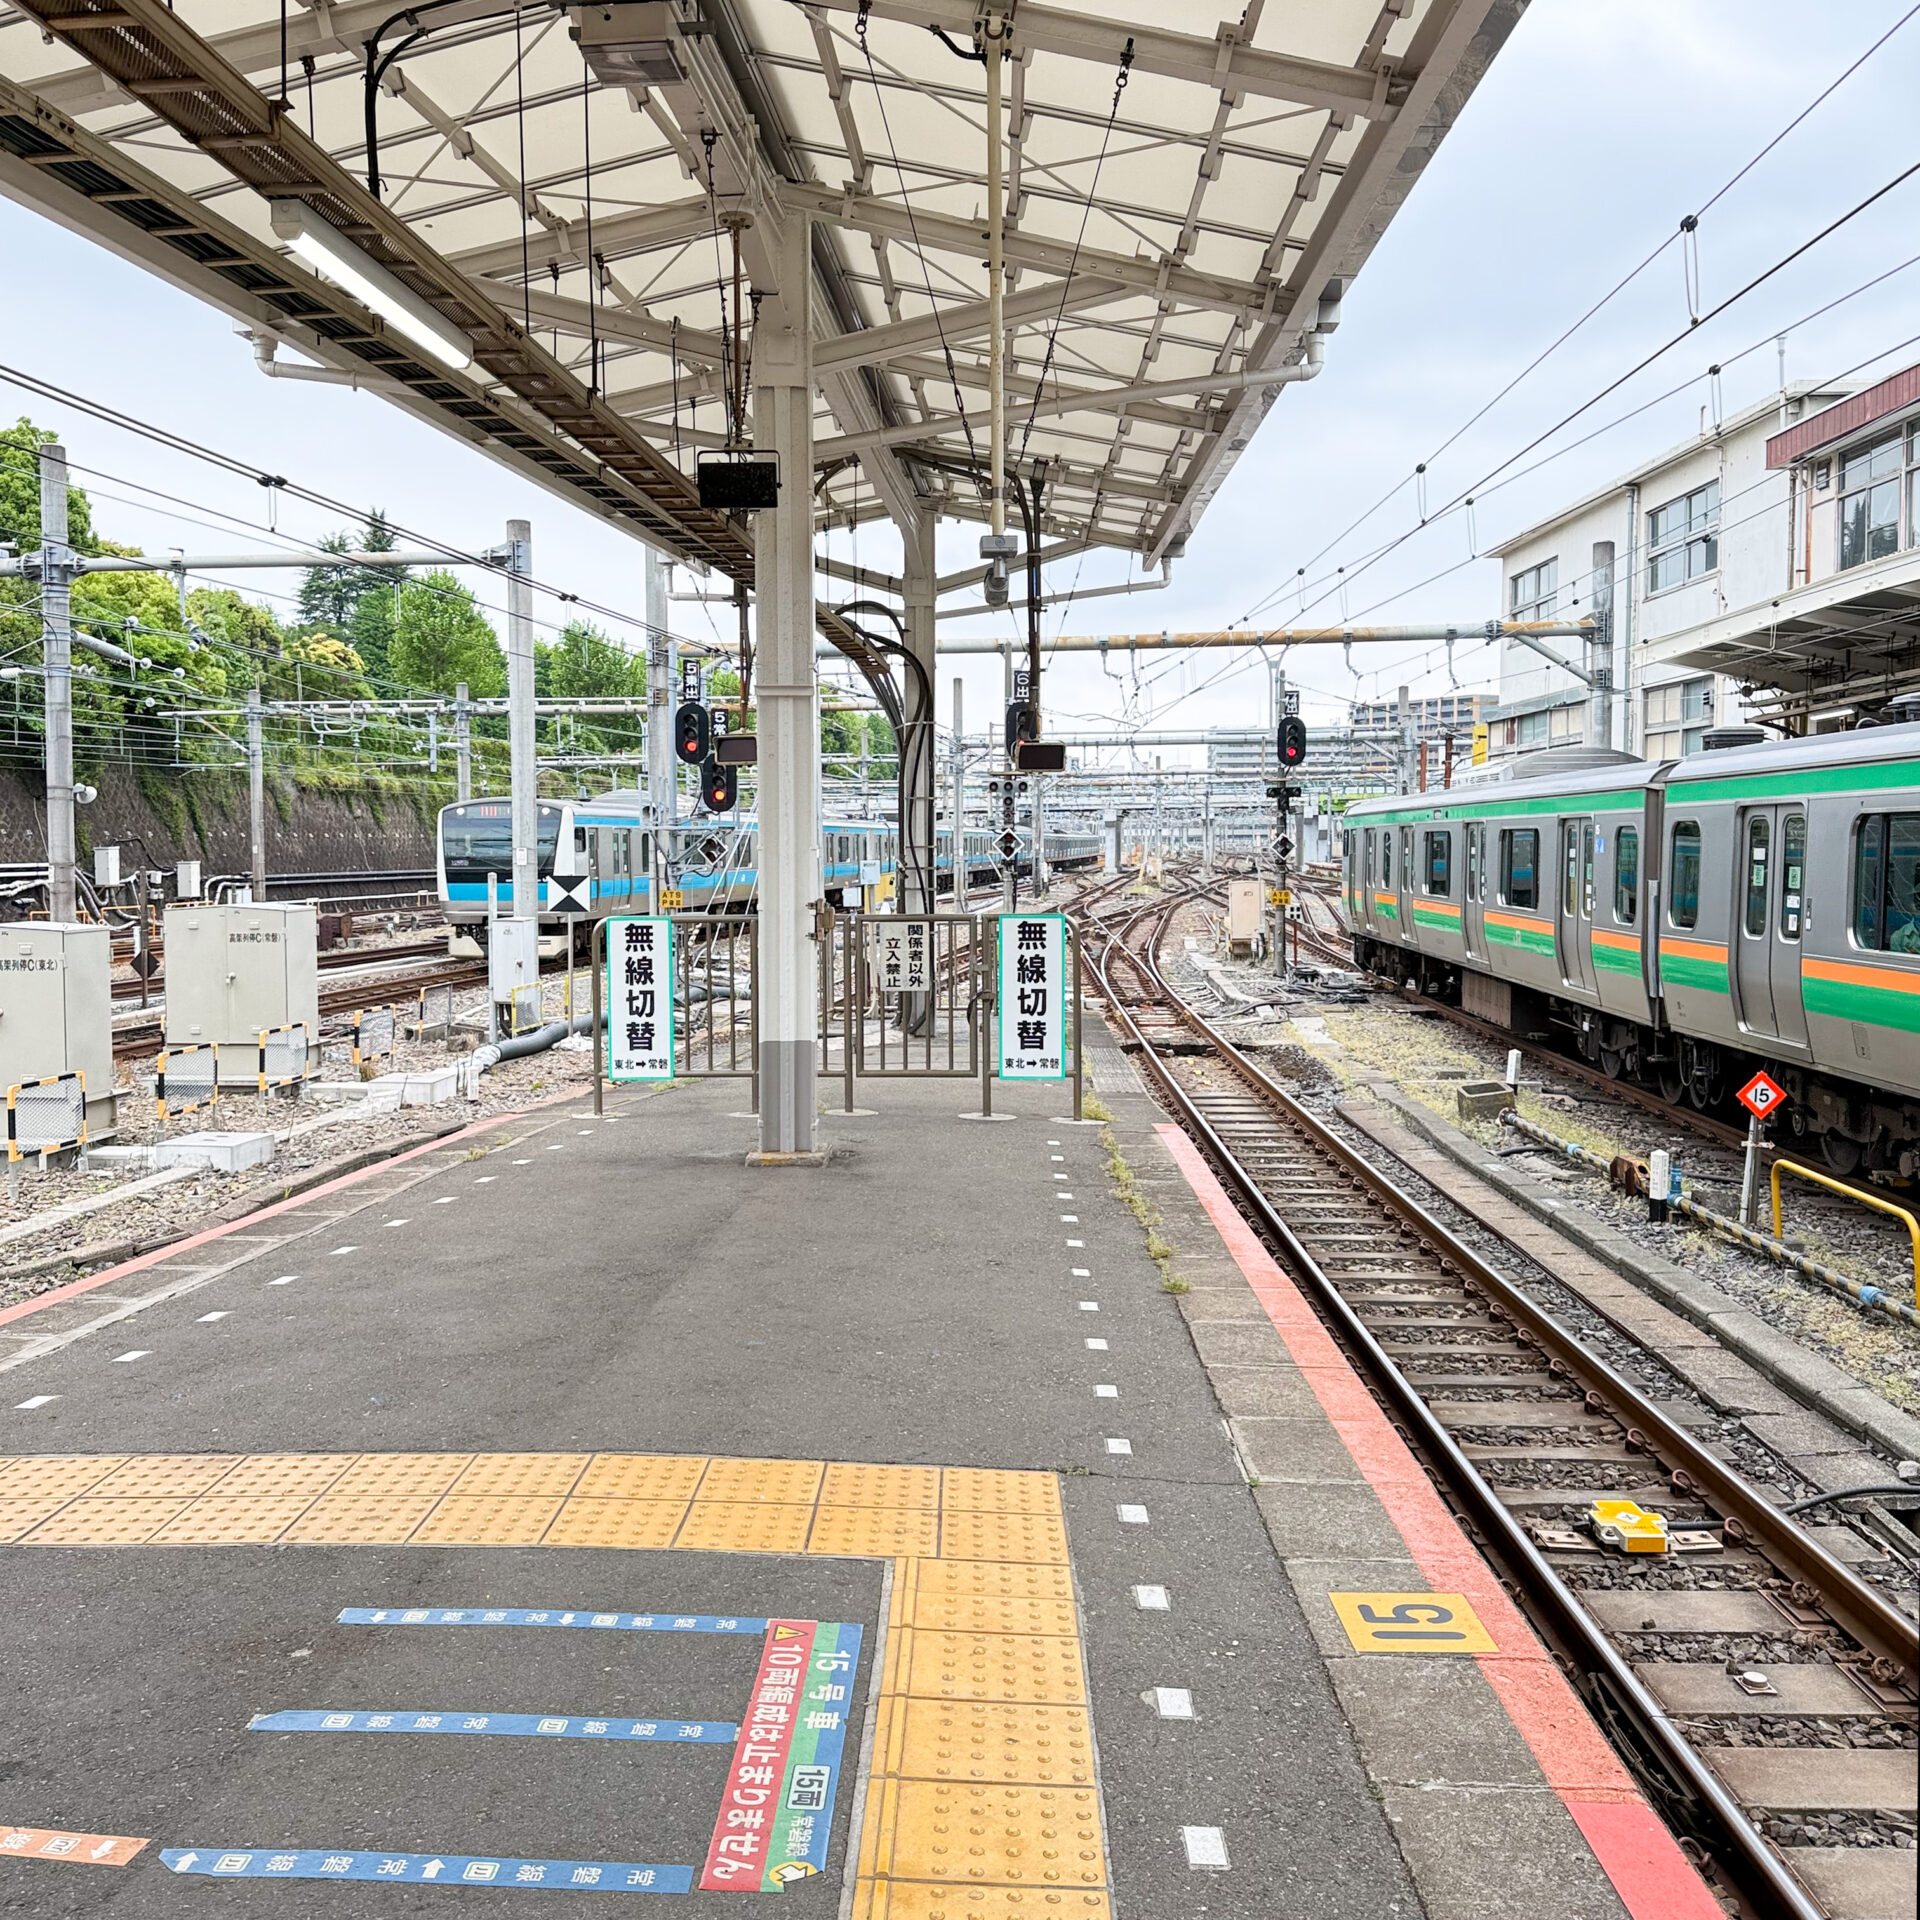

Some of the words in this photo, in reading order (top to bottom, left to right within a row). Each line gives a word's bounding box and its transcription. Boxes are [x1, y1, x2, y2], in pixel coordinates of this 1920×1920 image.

[686, 662, 698, 699] 5東出
[1016, 673, 1030, 698] 6出
[885, 937, 901, 988] 立入禁止
[908, 924, 924, 988] 関係者以外
[625, 923, 655, 1051] 無線切替
[1017, 921, 1047, 1050] 無線切替
[615, 1059, 634, 1070] 東北
[648, 1059, 668, 1070] 常磐
[1005, 1058, 1025, 1069] 東北
[1039, 1058, 1059, 1069] 常磐
[1754, 1088, 1770, 1103] 15
[1357, 1603, 1467, 1640] 15
[712, 1645, 804, 1880] 10両編成は止まりません
[791, 1769, 825, 1807] 15両
[784, 1815, 816, 1857] 常磐線
